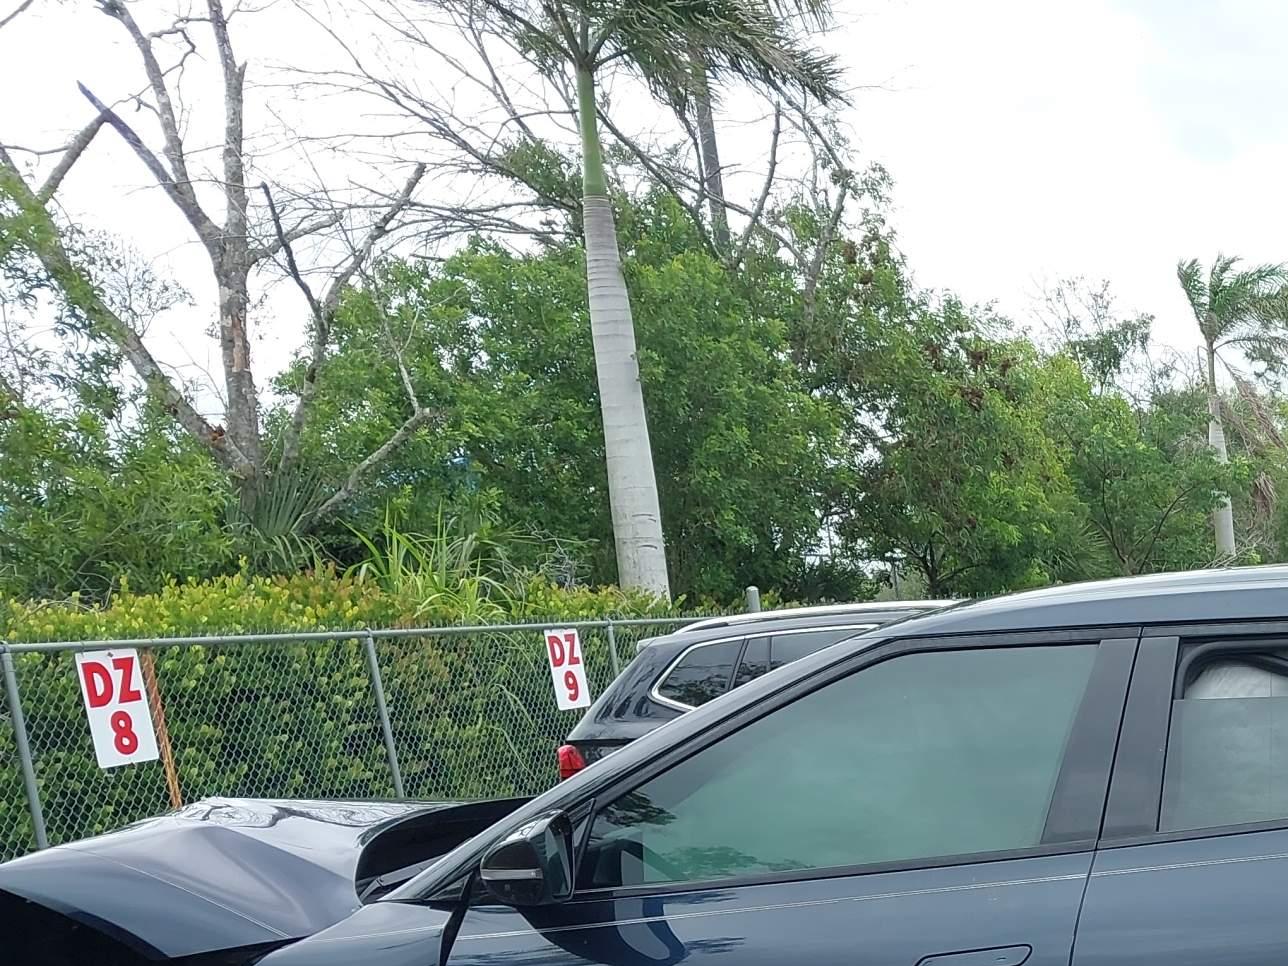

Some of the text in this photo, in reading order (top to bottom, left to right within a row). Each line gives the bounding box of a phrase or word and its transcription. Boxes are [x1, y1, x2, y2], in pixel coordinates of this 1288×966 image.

[547, 633, 580, 667] DZ
[81, 656, 141, 708] DZ
[564, 670, 578, 702] 9
[110, 710, 138, 755] 8
